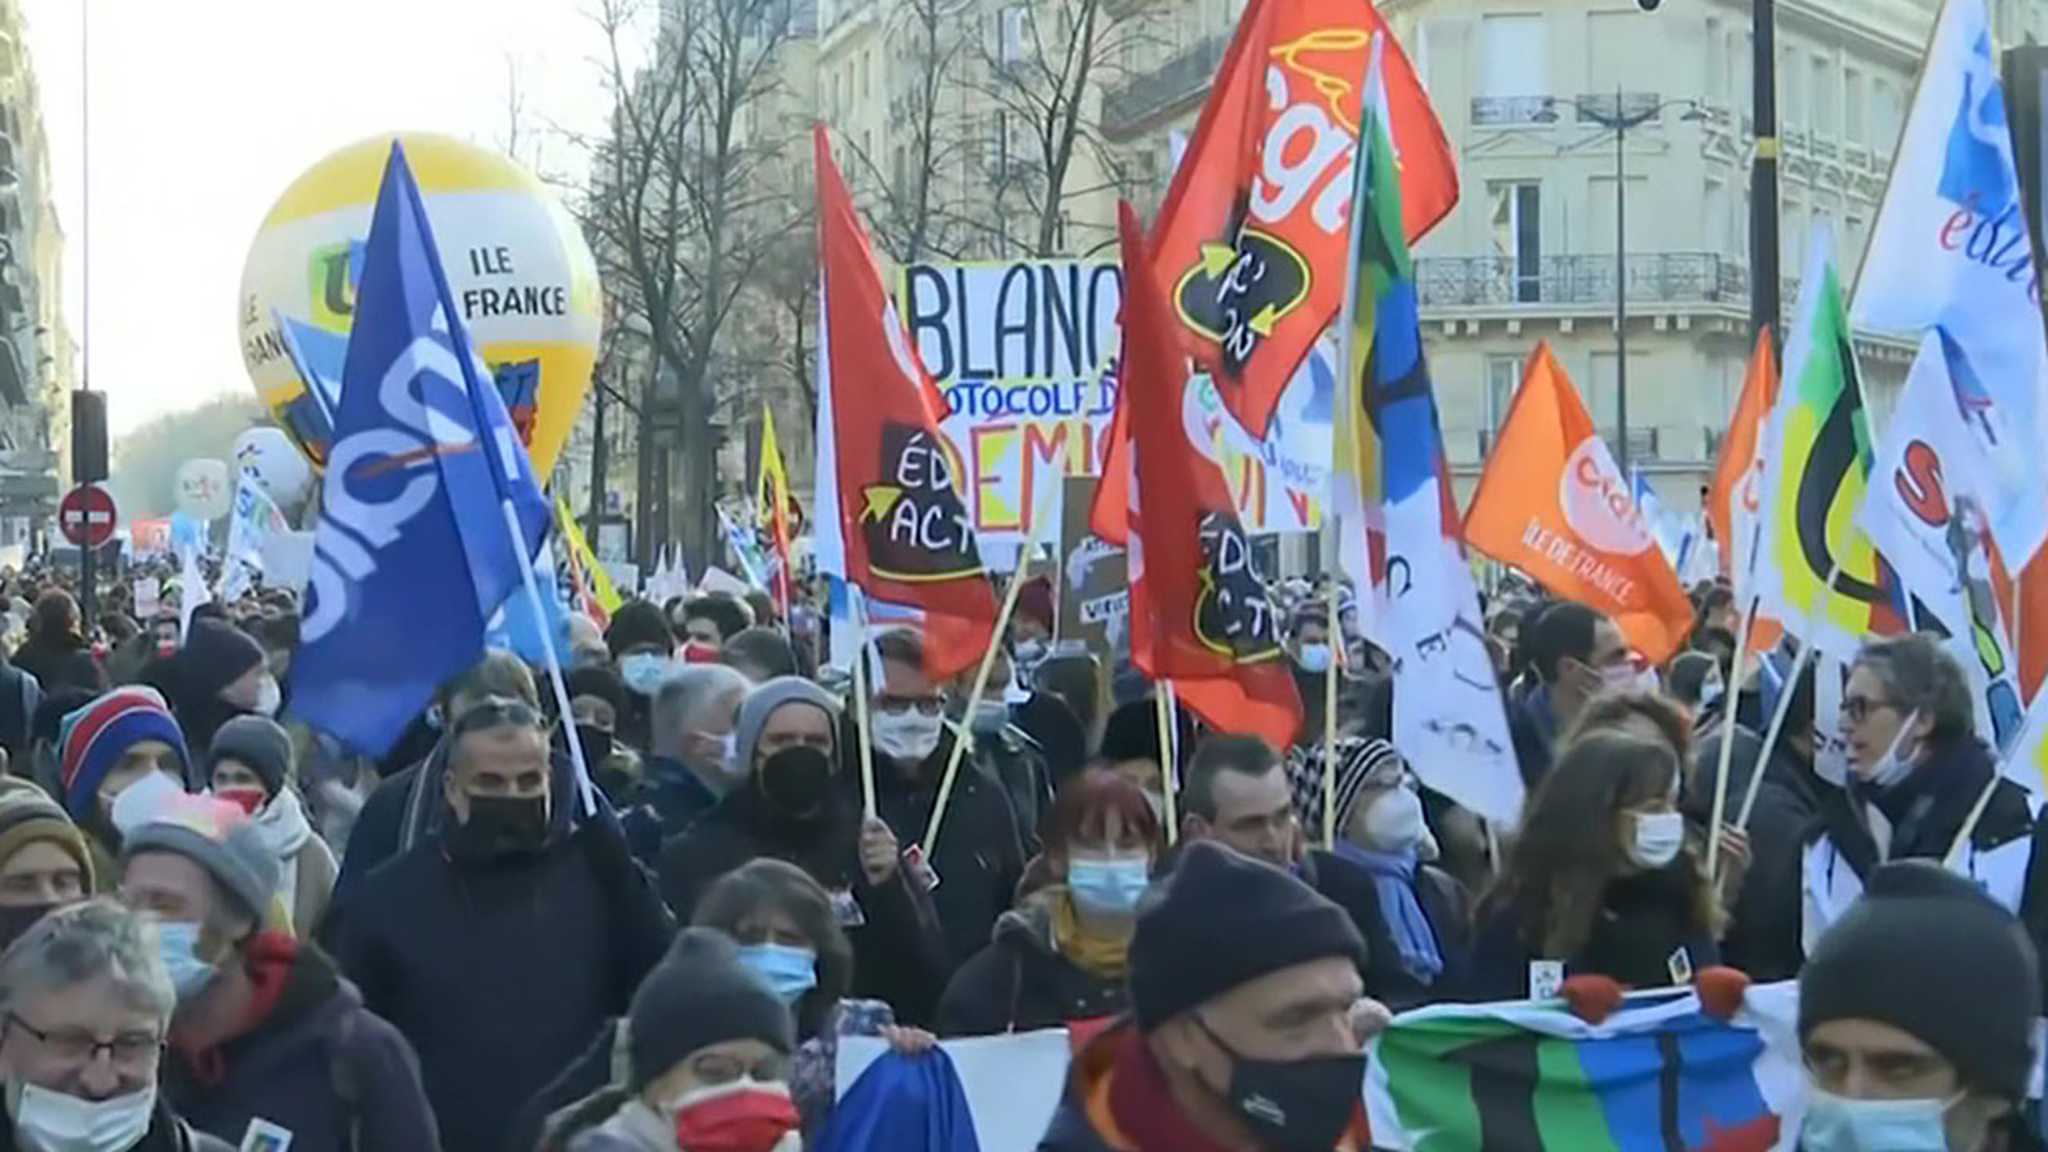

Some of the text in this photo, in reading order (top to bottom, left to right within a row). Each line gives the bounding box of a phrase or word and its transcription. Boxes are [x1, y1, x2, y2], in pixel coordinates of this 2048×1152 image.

[469, 246, 514, 276] ILE
[463, 285, 566, 320] FRANCE
[897, 432, 951, 491] ÉD
[890, 498, 969, 554] ACT
[1572, 549, 1634, 605] FRANCE
